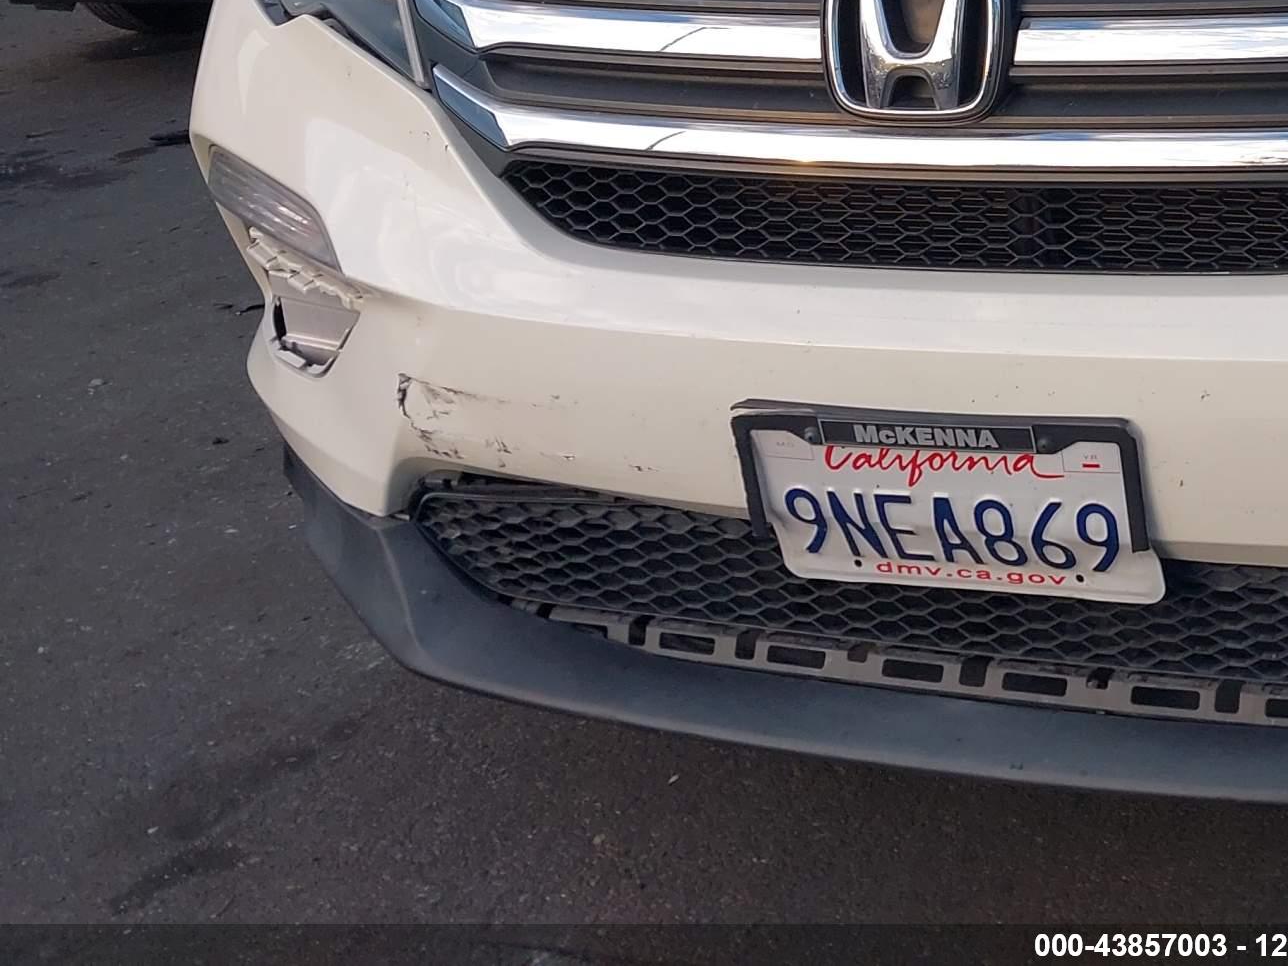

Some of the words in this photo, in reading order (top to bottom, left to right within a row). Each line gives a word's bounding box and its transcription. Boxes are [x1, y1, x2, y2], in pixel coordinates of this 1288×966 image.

[854, 424, 1000, 450] McKENNA
[824, 445, 1065, 487] California
[784, 487, 1121, 572] 9NEA869
[876, 561, 1067, 585] dmv.ca.gov
